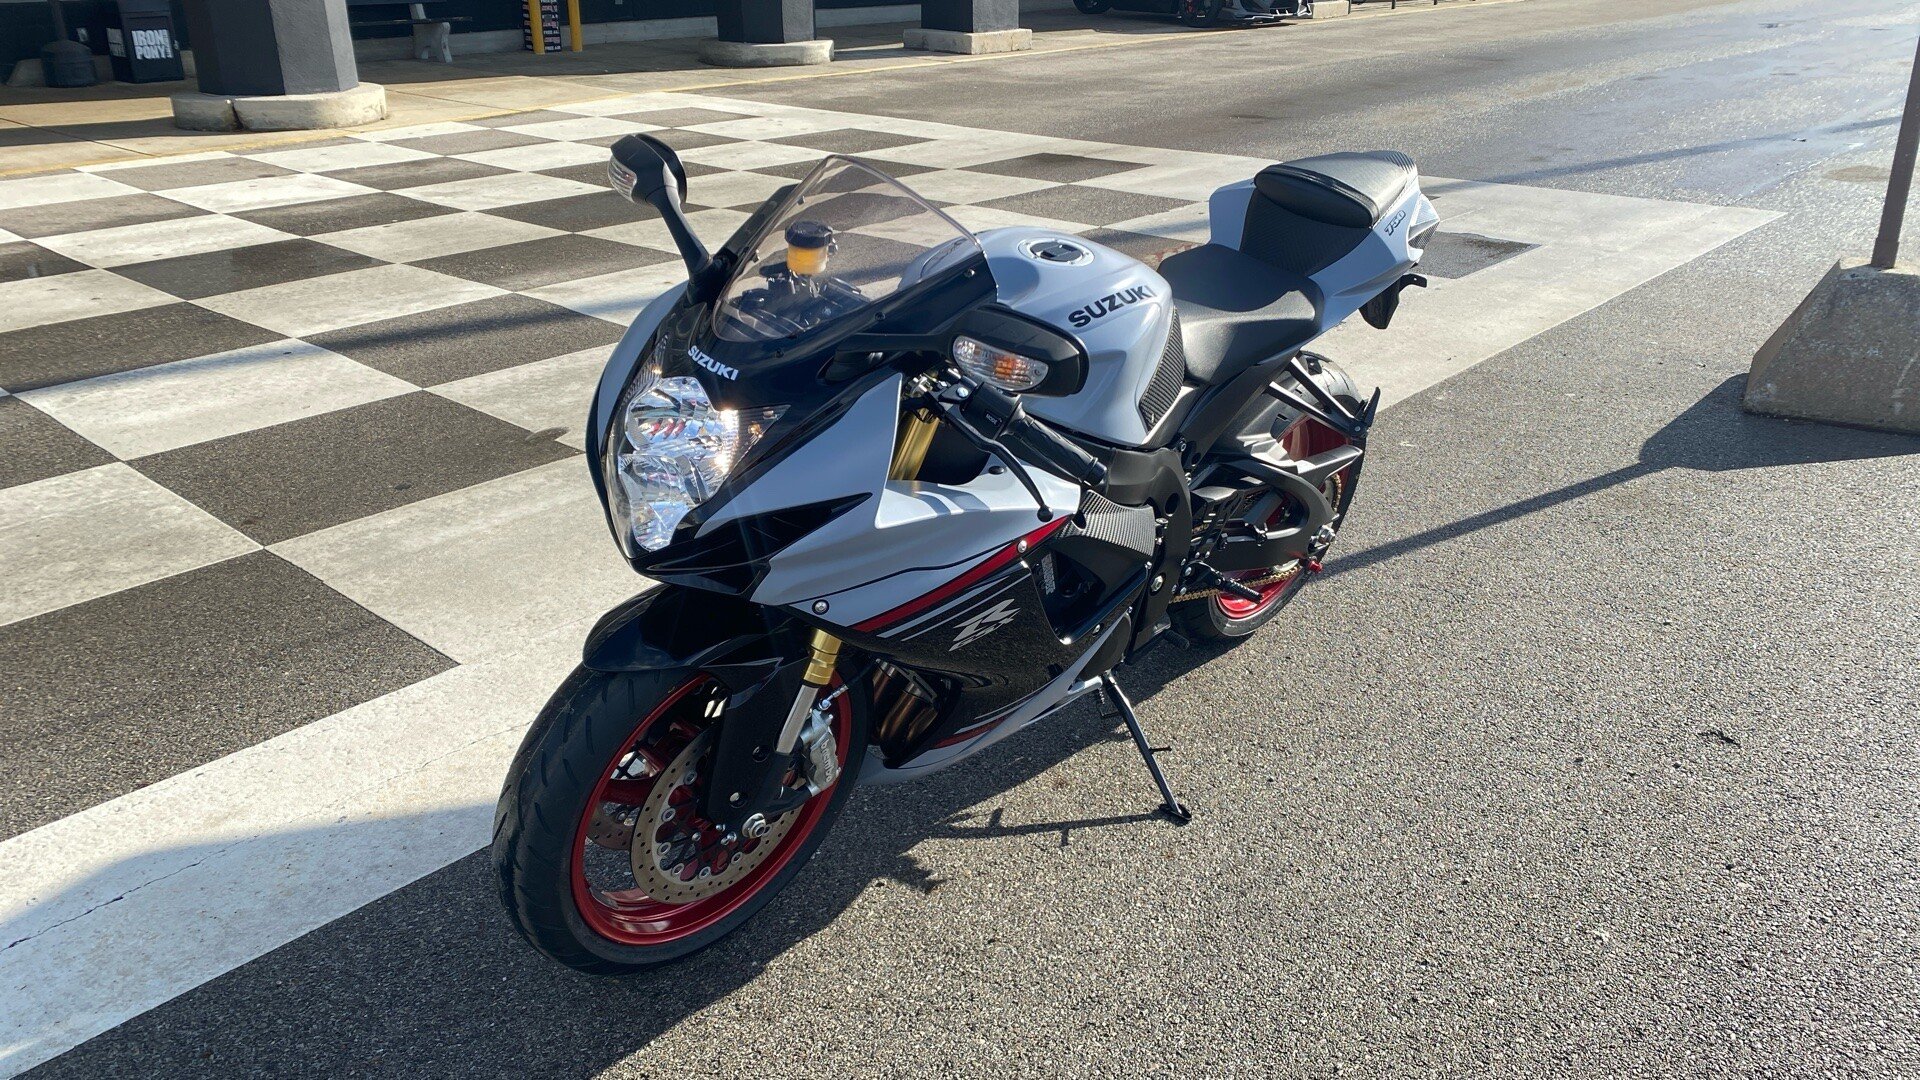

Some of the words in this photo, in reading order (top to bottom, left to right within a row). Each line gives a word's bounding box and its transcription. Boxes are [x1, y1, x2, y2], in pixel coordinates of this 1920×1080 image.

[131, 29, 166, 46] IRON
[134, 45, 167, 60] PONY
[1384, 210, 1406, 236] 750
[1068, 285, 1157, 328] SUZUKI
[688, 345, 739, 381] SUZUKI
[820, 738, 835, 783] brembo
